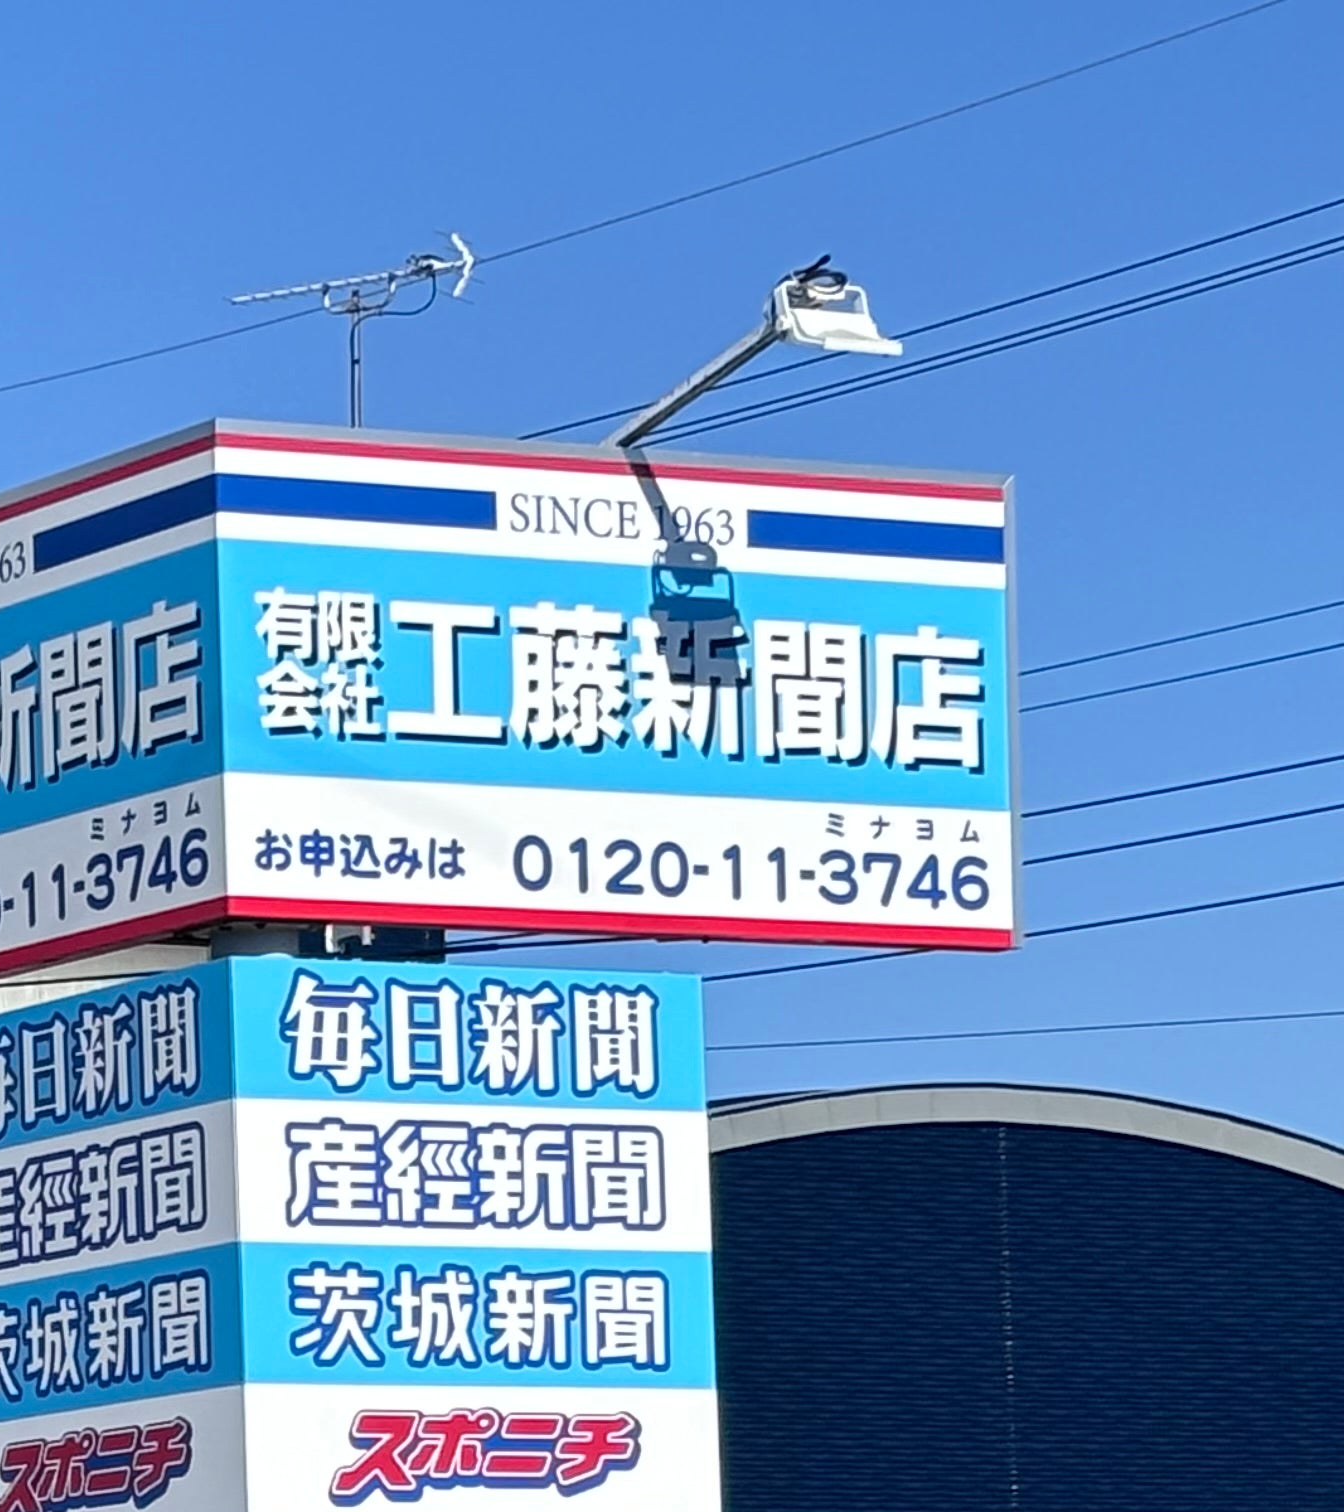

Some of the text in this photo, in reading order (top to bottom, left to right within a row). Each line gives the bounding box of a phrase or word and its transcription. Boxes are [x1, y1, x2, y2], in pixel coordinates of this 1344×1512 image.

[510, 492, 737, 547] SINCE 1963
[253, 586, 382, 666] 有限
[255, 660, 384, 740] 会社
[387, 600, 986, 774] 工藤新聞店
[254, 828, 992, 912] お申込みは 0120-11-3746
[280, 968, 660, 1098] 毎日新聞
[287, 1261, 668, 1373] 茨城新聞
[328, 1405, 641, 1508] スポニチ
